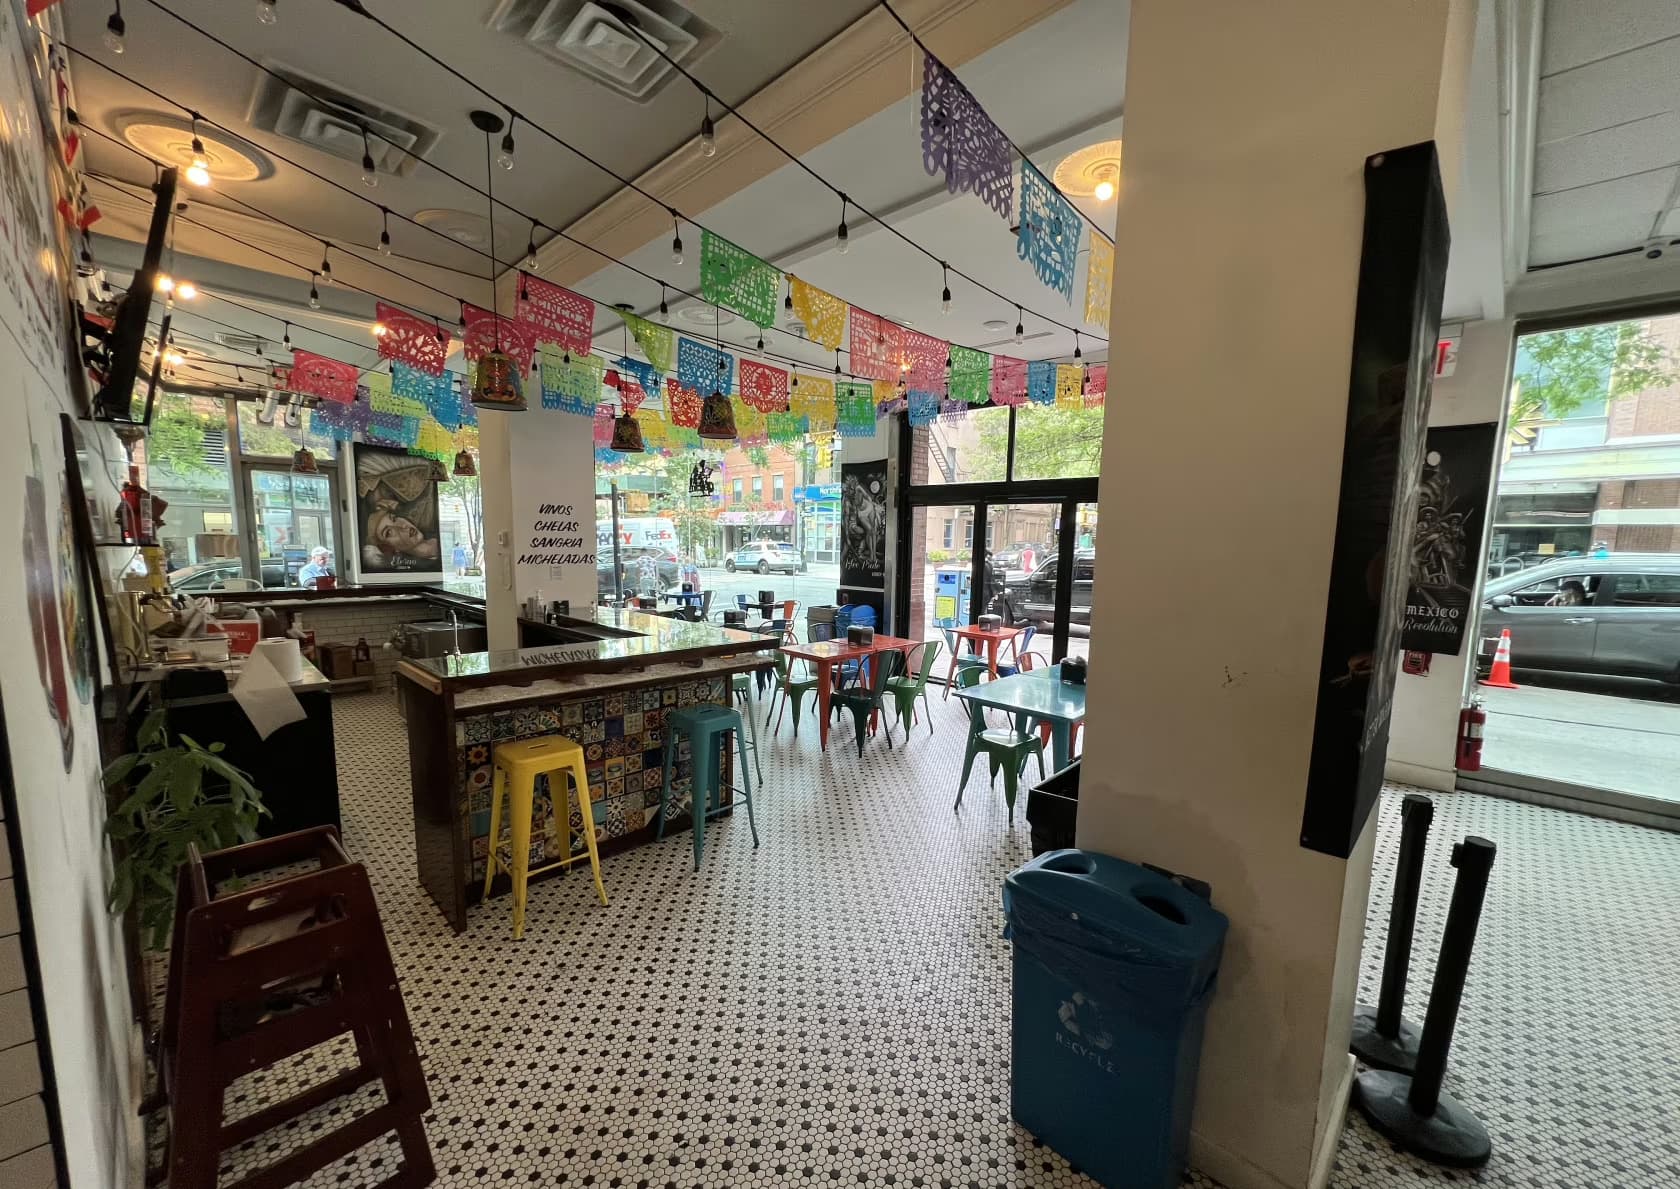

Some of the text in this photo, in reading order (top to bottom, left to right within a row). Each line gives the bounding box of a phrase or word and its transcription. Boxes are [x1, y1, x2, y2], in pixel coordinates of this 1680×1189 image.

[539, 503, 573, 515] VINOS
[534, 520, 579, 532] CHELAS
[645, 529, 672, 541] FedEx
[530, 537, 583, 548] SANGRIA
[517, 553, 596, 565] MICHELADAS
[1406, 605, 1460, 618] MEXICO
[1403, 617, 1458, 634] Revolution
